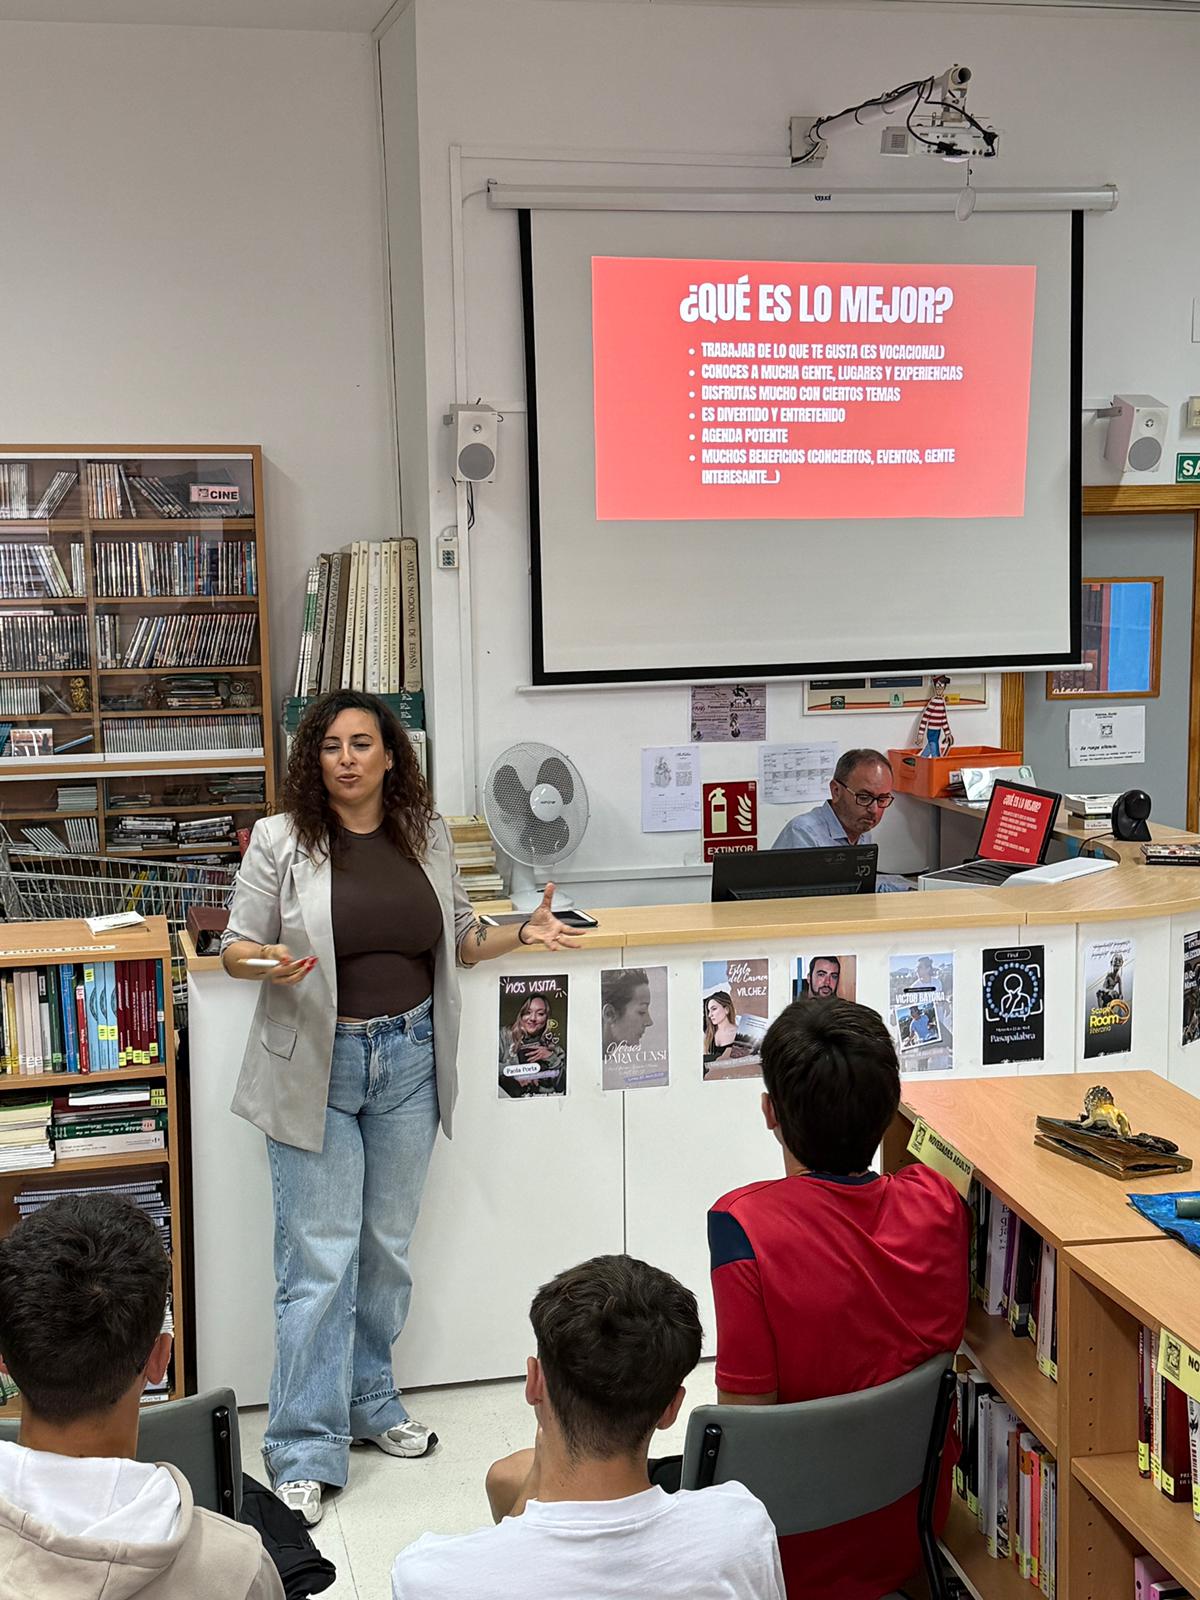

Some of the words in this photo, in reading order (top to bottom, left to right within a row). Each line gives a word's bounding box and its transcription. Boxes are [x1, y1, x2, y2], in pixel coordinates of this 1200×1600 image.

[679, 274, 751, 324] ¿QUÉ
[758, 284, 792, 323] ES
[799, 285, 832, 323] LO
[840, 285, 954, 324] MEJOR?
[701, 342, 755, 358] TRABAJAR
[757, 342, 772, 358] DE
[773, 343, 787, 359] LO
[788, 343, 809, 360] QUE
[811, 343, 824, 359] TE
[825, 344, 858, 359] GUSTA
[860, 344, 877, 359] (ES
[879, 344, 945, 360] VOCACIONAL)
[701, 364, 749, 380] CONOCES
[751, 364, 759, 380] A
[760, 364, 800, 380] MUCHA
[801, 365, 836, 382] GENTE,
[838, 366, 883, 381] LUGARES
[885, 366, 893, 381] Y
[894, 366, 964, 381] EXPERIENCIAS
[701, 385, 757, 401] DISFRUTAS
[758, 386, 797, 401] MUCHO
[799, 386, 821, 401] CON
[822, 386, 864, 402] CIERTOS
[865, 387, 901, 402] TEMAS
[701, 407, 715, 422] ES
[717, 407, 769, 422] DIVERTIDO
[770, 407, 778, 422] Y
[780, 407, 846, 422] ENTRETENIDO
[701, 428, 743, 443] AGENDA
[744, 428, 788, 443] POTENTE
[701, 449, 747, 464] MUCHOS
[748, 449, 805, 464] BENEFICIOS
[807, 449, 874, 465] (CONCIERTOS,
[876, 449, 923, 465] EVENTOS,
[924, 448, 955, 463] GENTE
[210, 490, 238, 500] CINE
[707, 844, 754, 856] EXTINTOR
[505, 981, 526, 994] NOS
[737, 986, 767, 997] VILCHEZ
[1090, 1014, 1119, 1028] Room
[990, 1032, 1036, 1044] Pasapalabra
